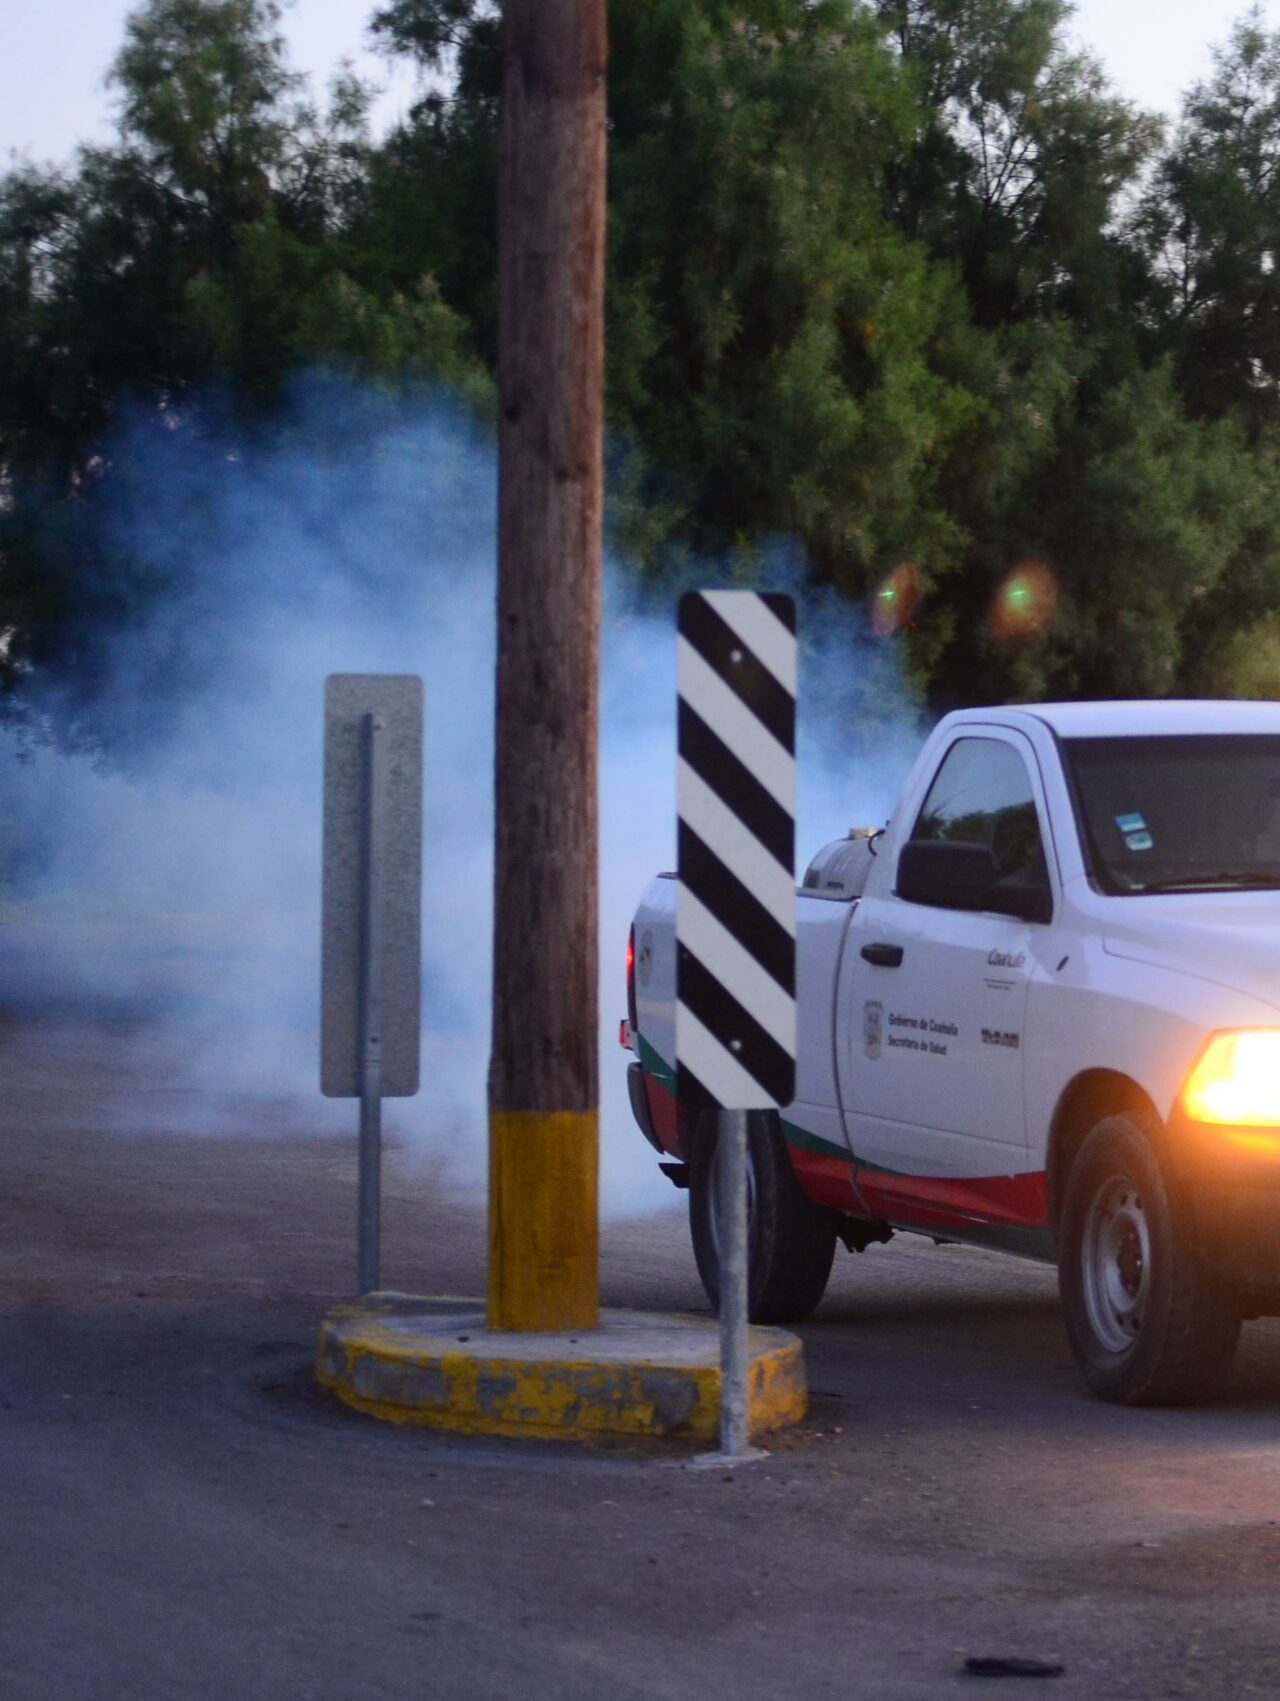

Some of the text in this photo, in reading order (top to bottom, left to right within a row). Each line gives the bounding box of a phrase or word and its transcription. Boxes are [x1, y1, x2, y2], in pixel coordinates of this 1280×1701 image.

[888, 1013, 959, 1037] Gobierno de Coahuila
[920, 1040, 928, 1052] de
[929, 1041, 947, 1056] Salud
